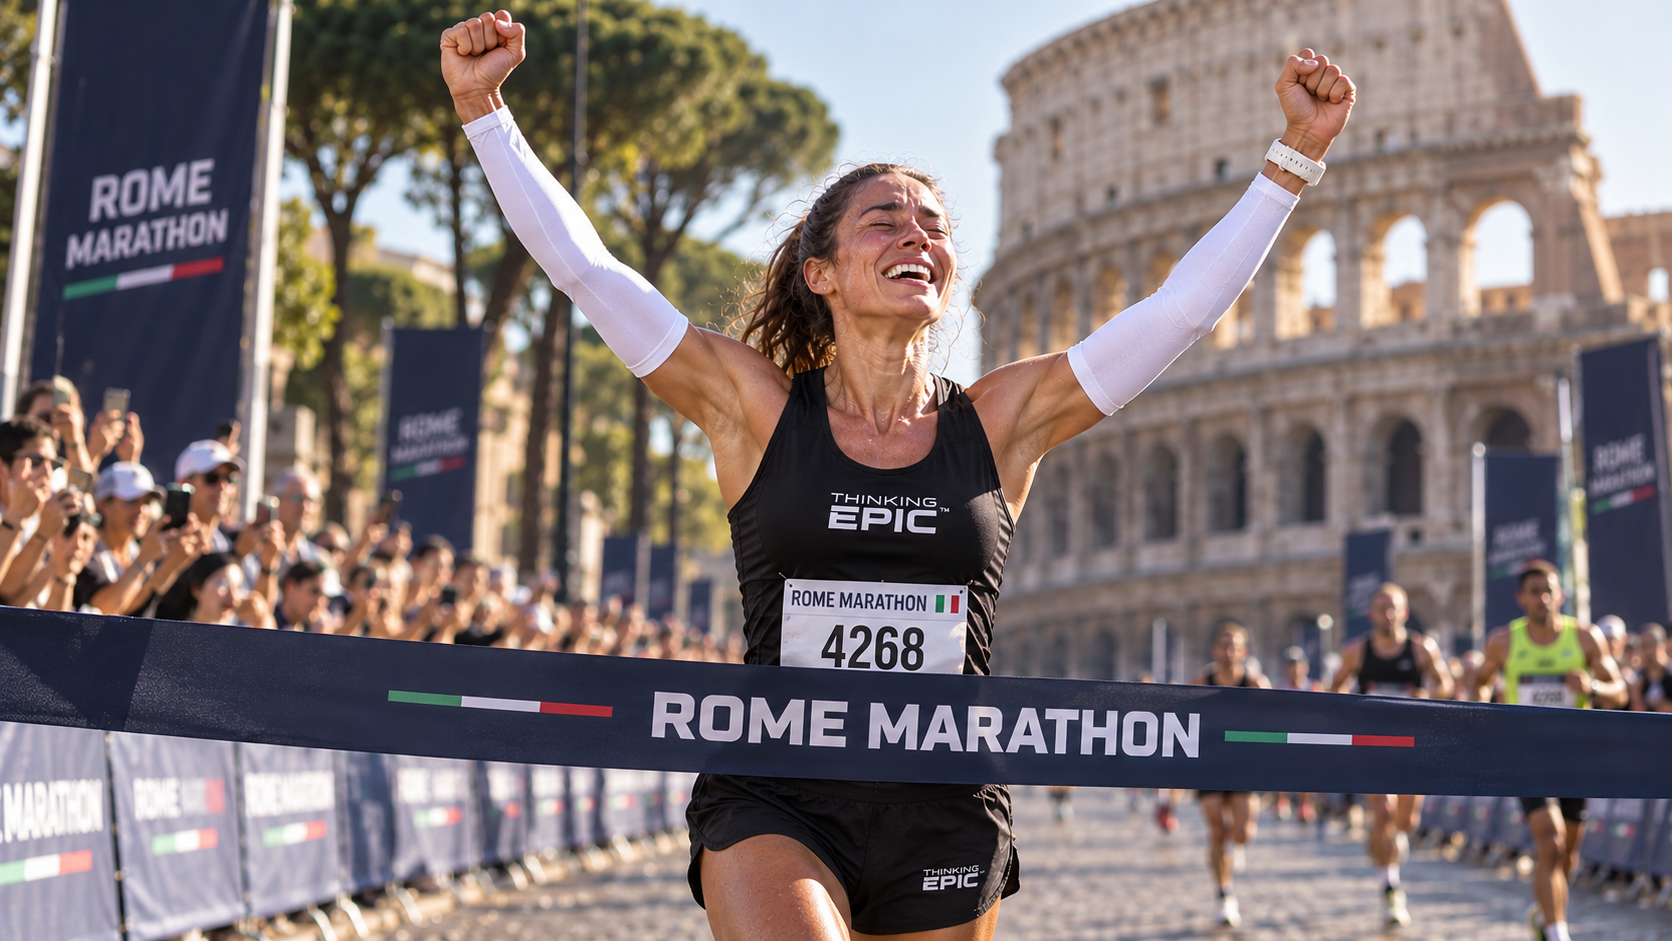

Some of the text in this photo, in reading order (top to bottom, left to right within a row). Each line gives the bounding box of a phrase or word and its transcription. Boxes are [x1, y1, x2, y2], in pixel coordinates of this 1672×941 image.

[89, 158, 215, 223] ROME
[65, 208, 229, 270] MARATHON
[831, 492, 937, 508] THINKING
[828, 505, 938, 535] EPIC
[791, 590, 927, 612] ROME MARATHON
[821, 624, 925, 671] 4268
[651, 690, 1201, 758] ROME MARATHON
[3, 778, 103, 844] MARATHON
[922, 872, 979, 891] EPIC
[923, 865, 979, 876] THINKING
